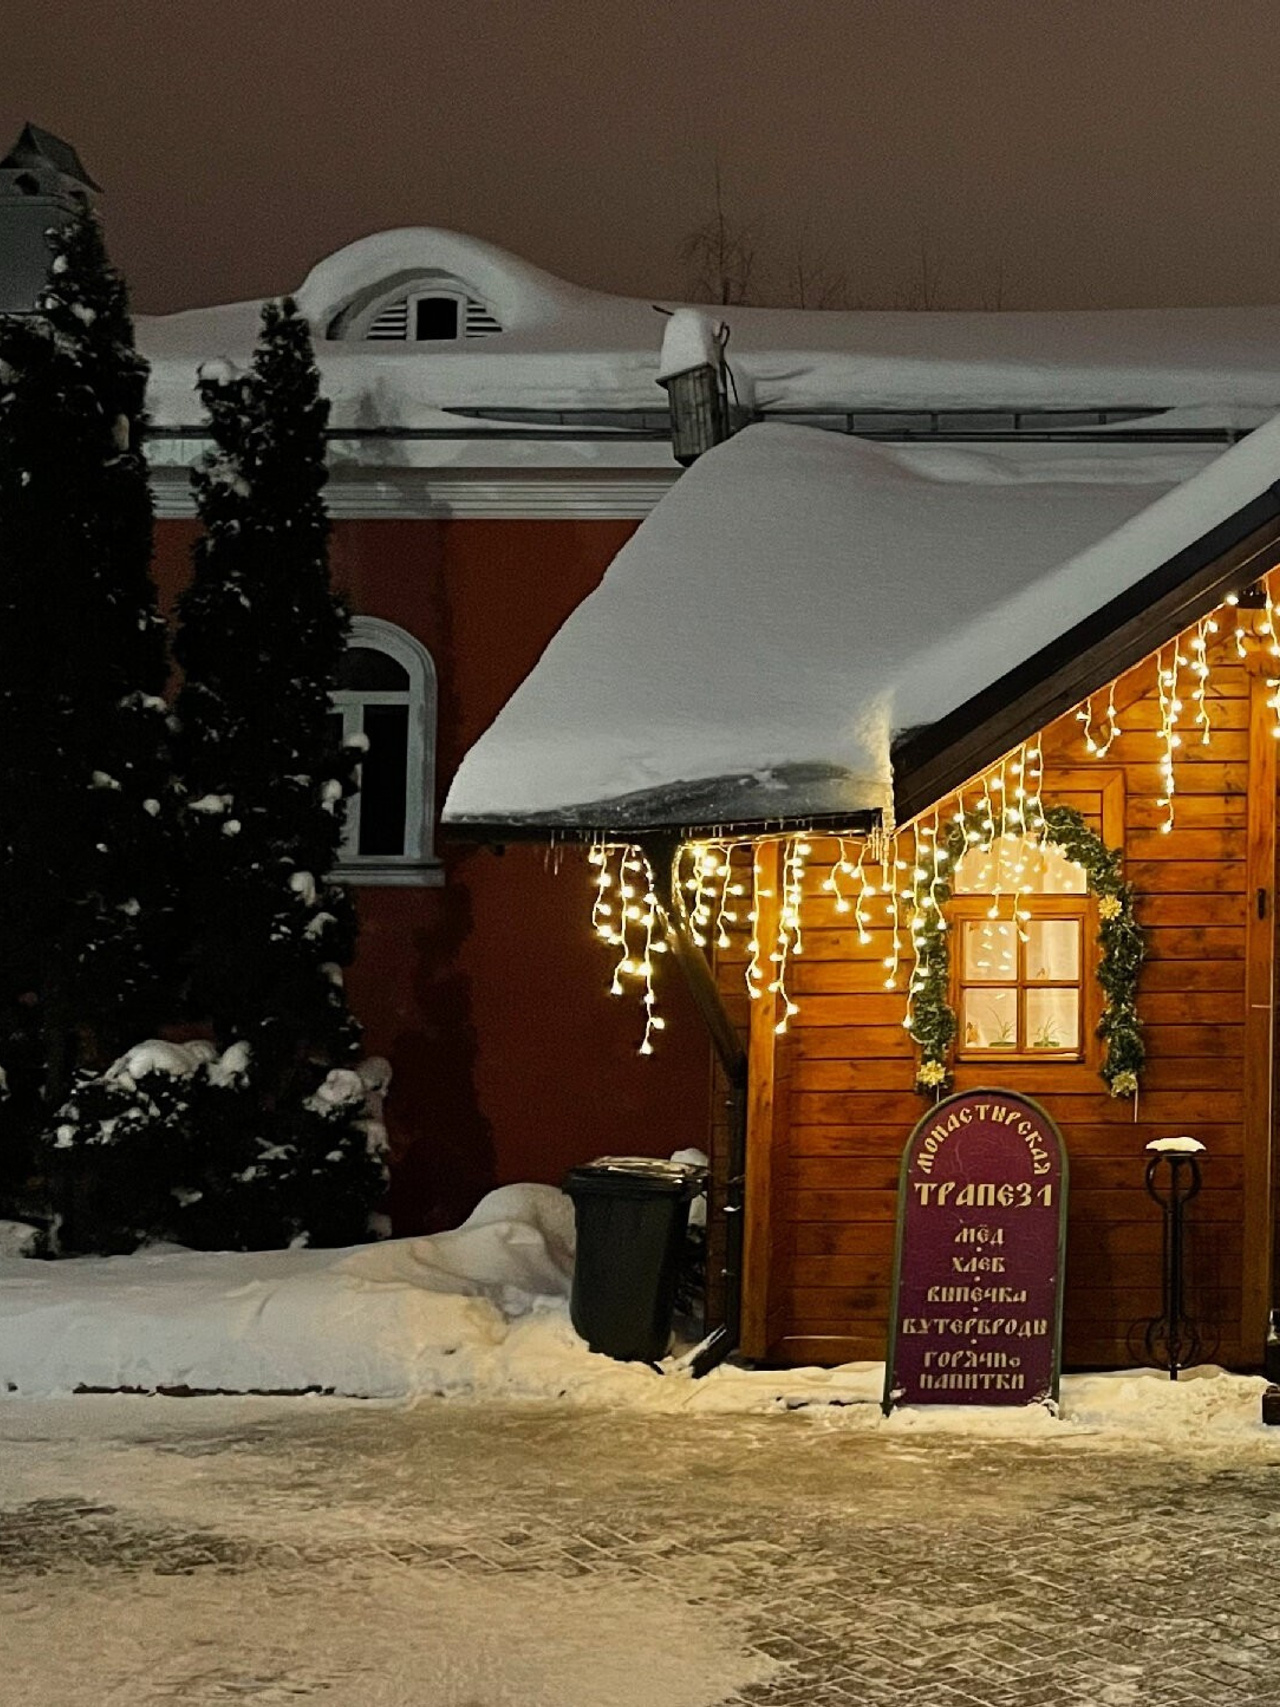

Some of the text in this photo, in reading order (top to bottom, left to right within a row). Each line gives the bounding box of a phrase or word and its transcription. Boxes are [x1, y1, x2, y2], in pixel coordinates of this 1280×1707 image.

[916, 1103, 1052, 1175] МОНАСТЫРСКАЯ
[913, 1181, 1053, 1208] ТРАПЕЗА
[954, 1223, 1005, 1246] МЁД
[952, 1256, 1007, 1273] ХЛЕБ
[926, 1285, 1028, 1303] ВЫПЕЧКА
[902, 1317, 1049, 1338] БУТЕРБРОДЫ
[919, 1373, 1025, 1390] НАПИТКИ
